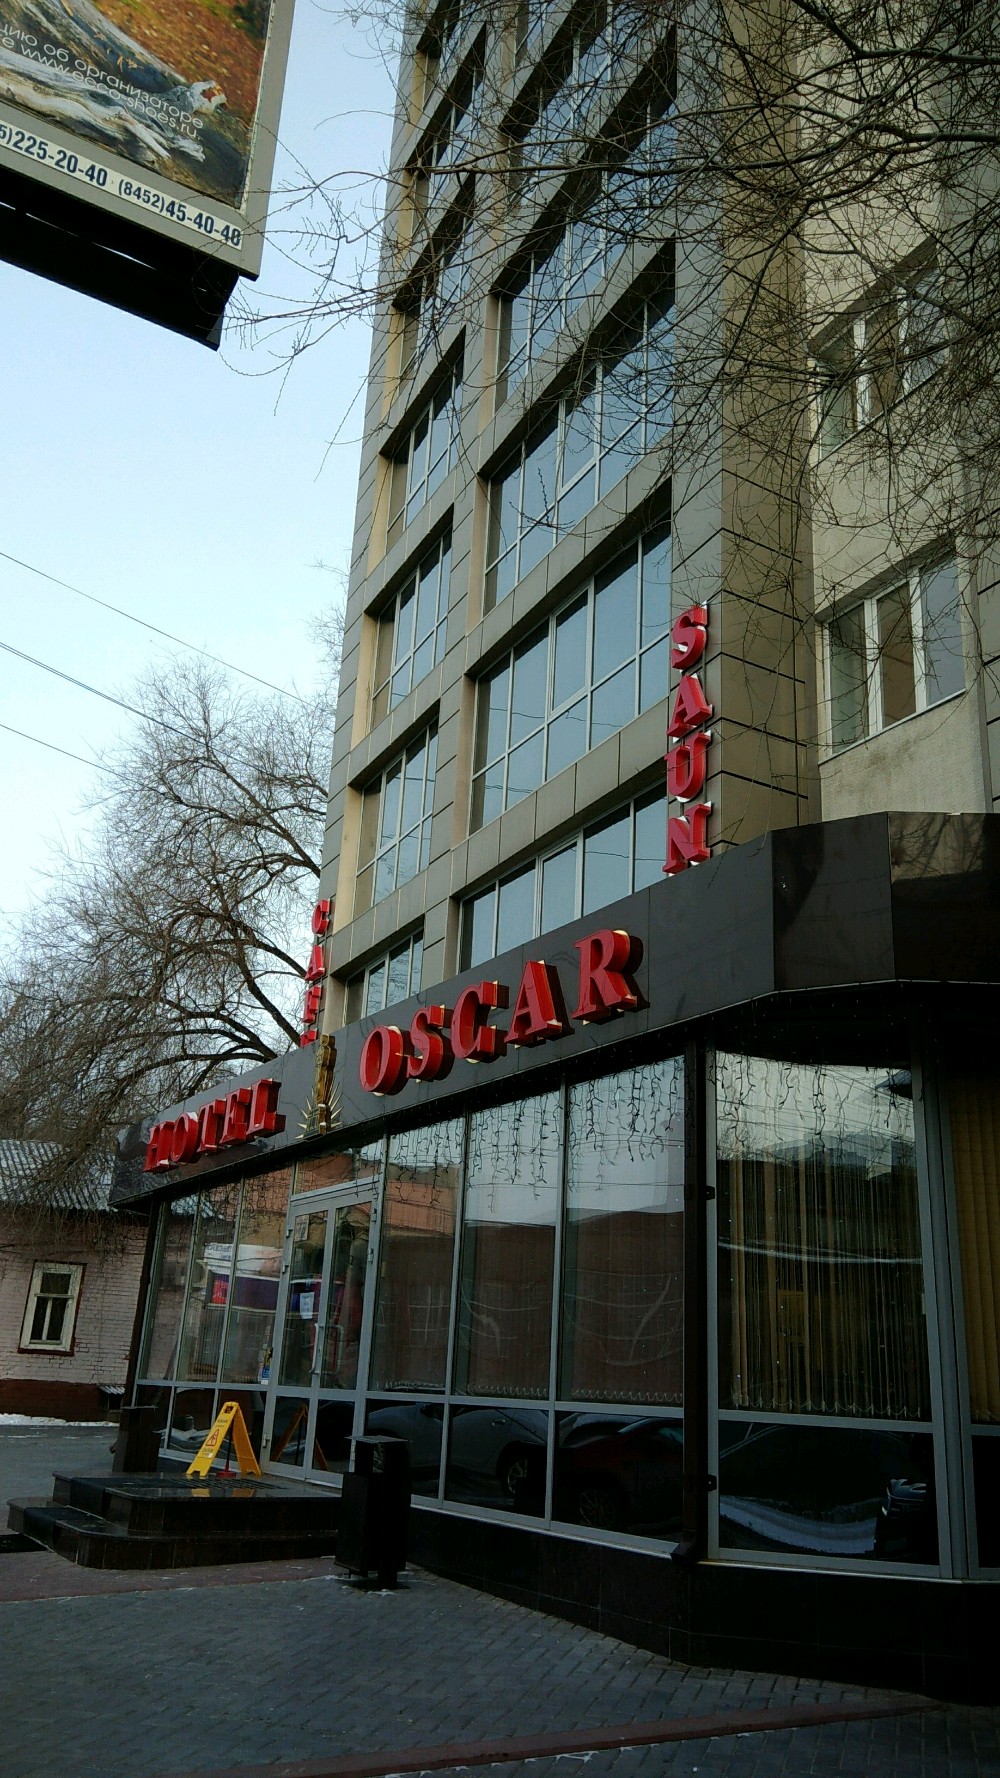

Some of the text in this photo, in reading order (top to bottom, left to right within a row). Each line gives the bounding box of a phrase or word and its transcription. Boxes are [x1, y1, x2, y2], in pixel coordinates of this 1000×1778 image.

[44, 44, 69, 62] об
[75, 60, 204, 129] организаторе
[118, 179, 241, 246] (8452)45-40-48
[662, 601, 713, 876] SAUN
[143, 930, 647, 1174] HOTEL OSCAR
